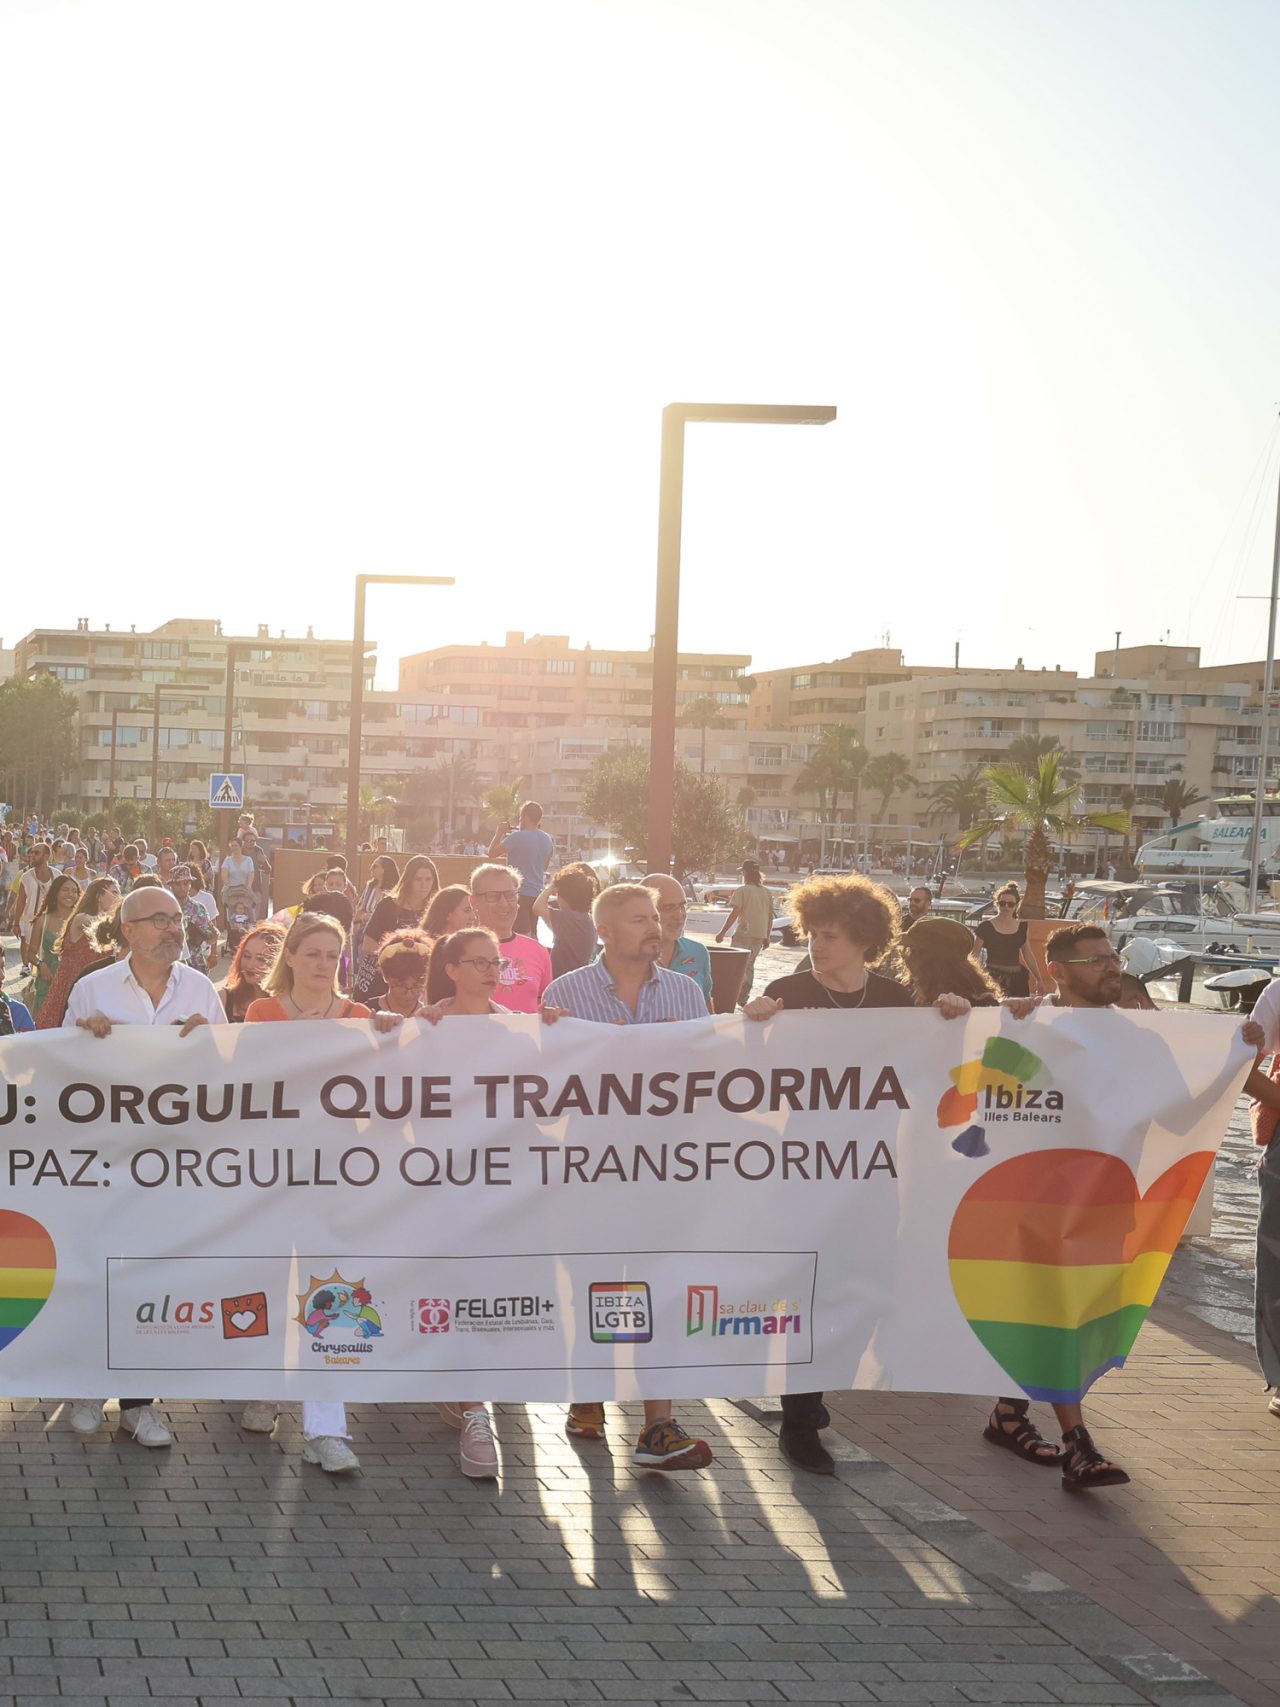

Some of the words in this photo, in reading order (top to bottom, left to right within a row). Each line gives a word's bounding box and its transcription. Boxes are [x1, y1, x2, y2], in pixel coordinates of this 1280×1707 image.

[1212, 827, 1267, 840] BALEARA
[58, 1080, 300, 1126] ORGULL
[320, 1075, 452, 1120] QUE
[474, 1065, 911, 1120] TRANSFORMA
[984, 1083, 1064, 1111] Ibiza
[984, 1112, 1009, 1122] Illes
[1013, 1112, 1062, 1124] Balears
[8, 1148, 112, 1188] PAZ:
[130, 1146, 381, 1188] ORGULLO
[399, 1146, 512, 1187] QUE
[529, 1140, 899, 1186] TRANSFORMA
[135, 1295, 215, 1324] alas
[455, 1296, 554, 1319] FELGTBI+
[595, 1296, 645, 1308] IBIZA
[720, 1305, 734, 1314] sa
[738, 1301, 767, 1314] clau
[771, 1299, 787, 1312] de
[595, 1311, 646, 1329] LGTB
[311, 1342, 374, 1354] Chrysallis
